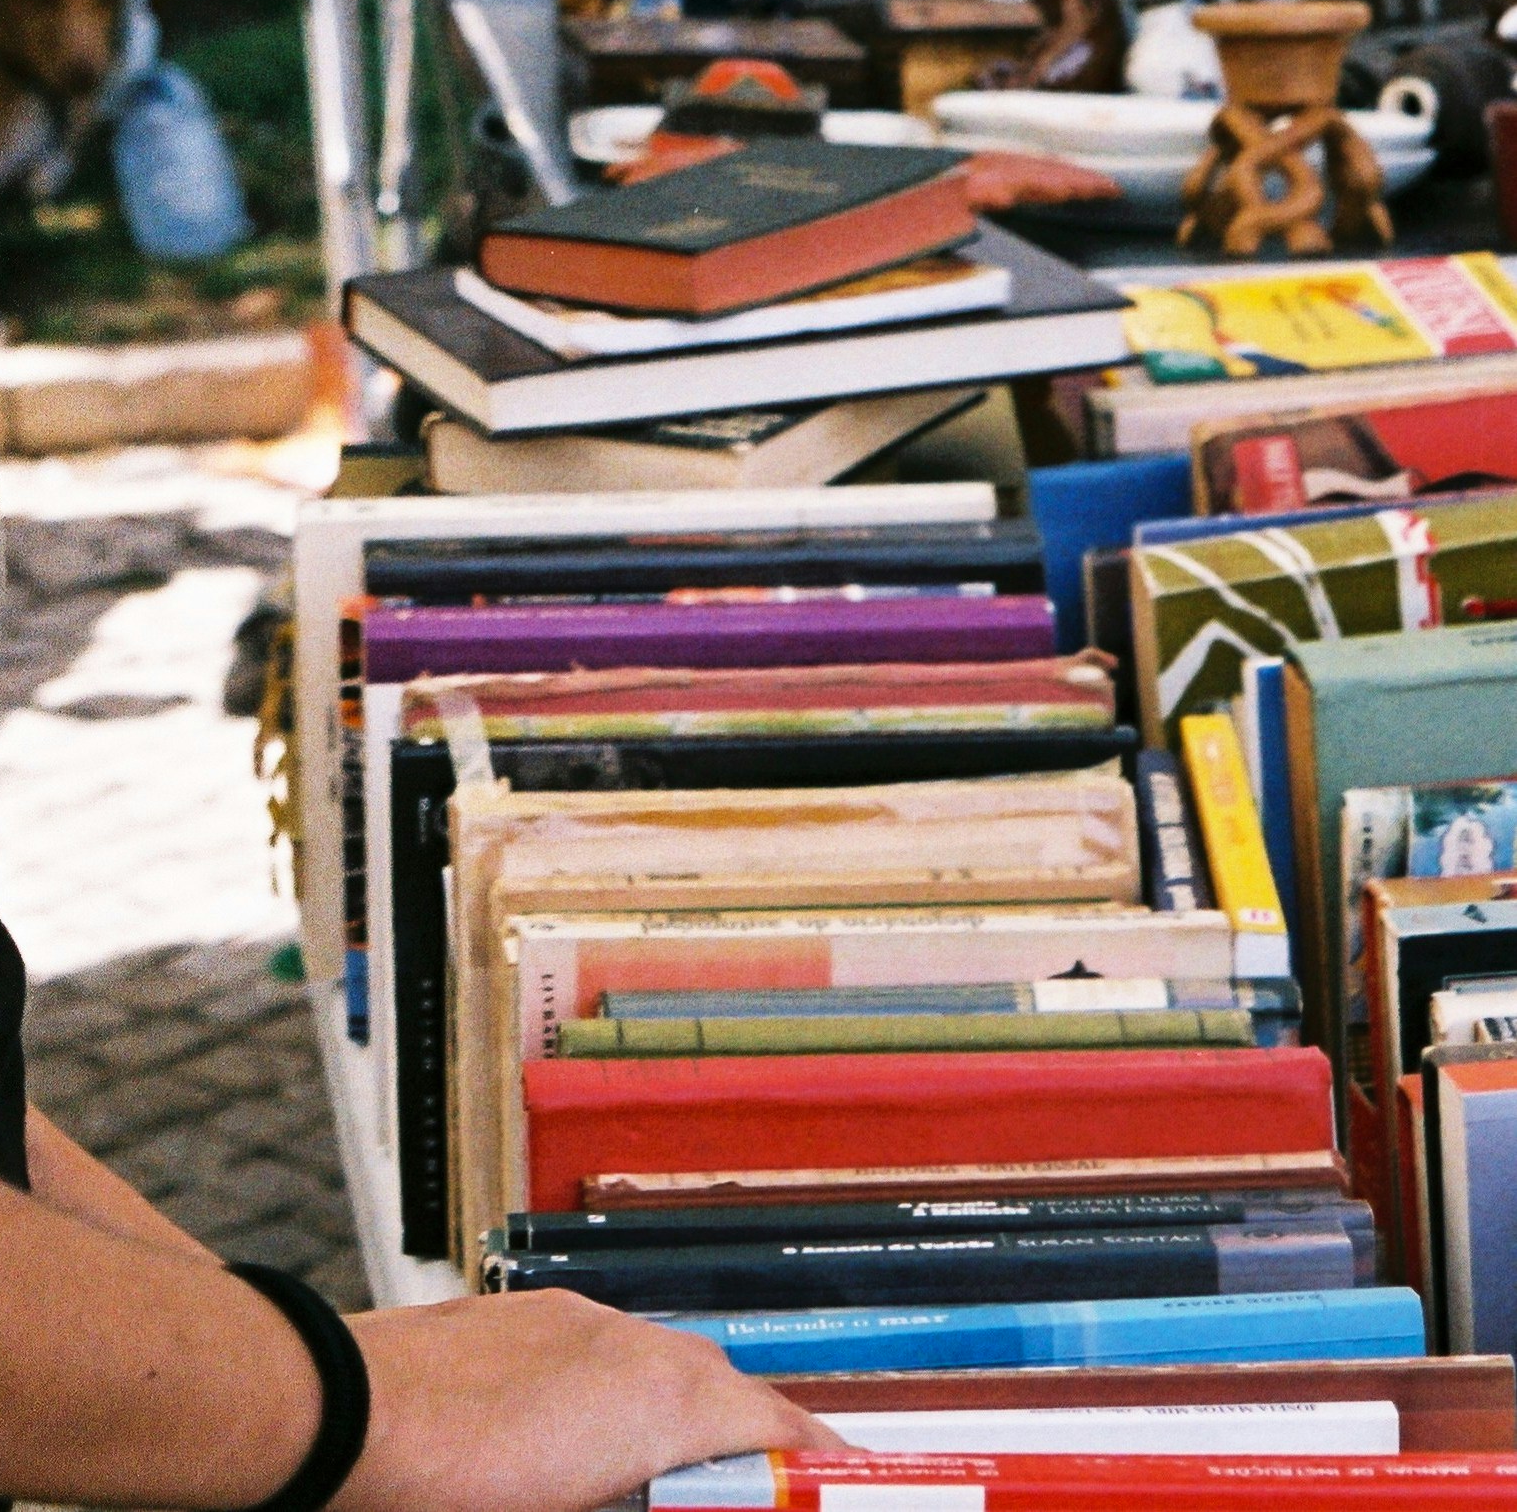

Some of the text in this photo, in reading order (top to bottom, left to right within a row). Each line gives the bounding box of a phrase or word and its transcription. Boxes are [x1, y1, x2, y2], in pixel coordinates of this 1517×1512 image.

[1050, 1205, 1118, 1215] LAURA
[1017, 1237, 1094, 1247] SUSAN
[1102, 1233, 1202, 1244] SONTAG
[878, 1313, 950, 1327] mar
